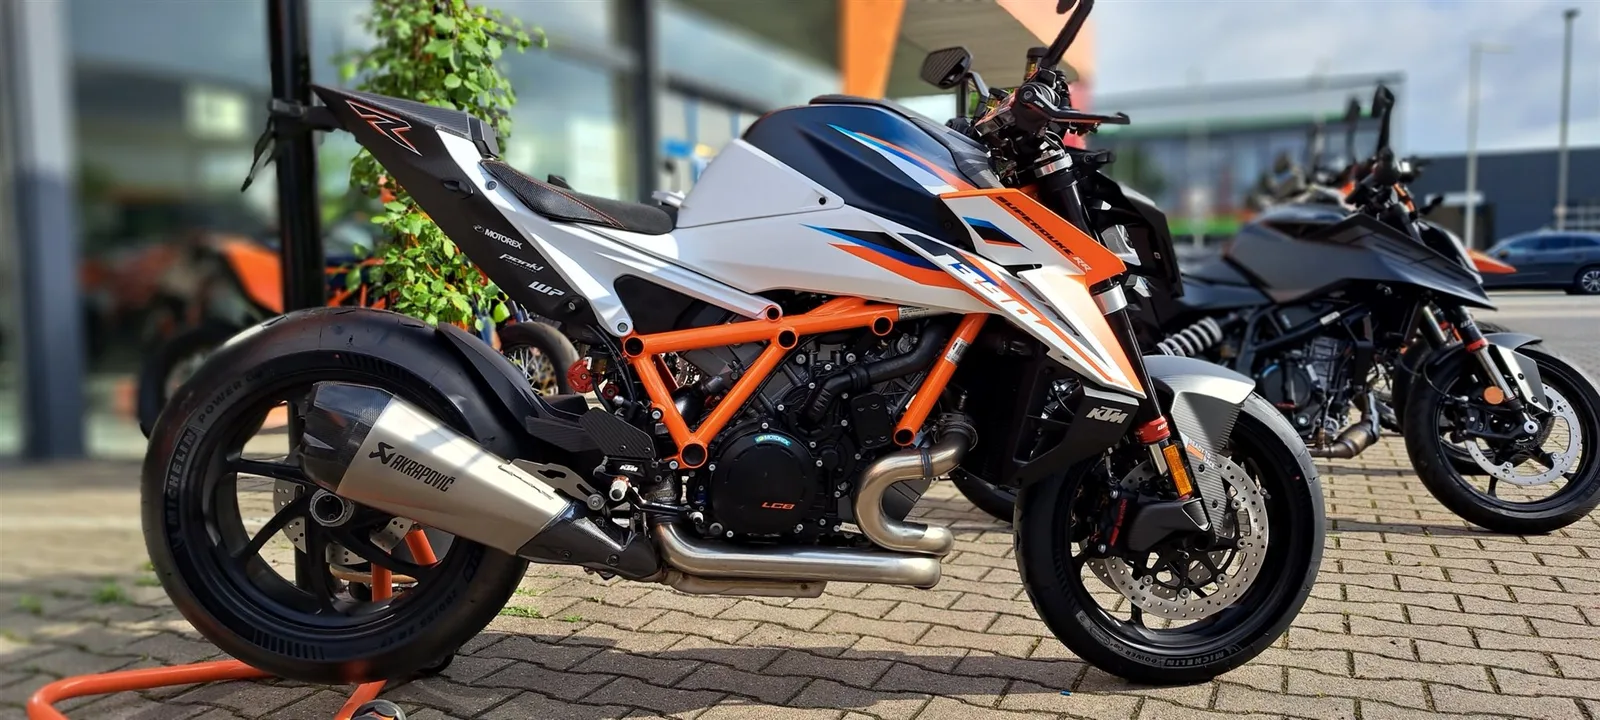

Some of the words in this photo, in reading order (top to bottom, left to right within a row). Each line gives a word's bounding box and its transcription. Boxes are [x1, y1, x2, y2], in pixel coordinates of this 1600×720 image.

[485, 228, 522, 249] MOTOREX
[1073, 256, 1092, 271] RR
[528, 281, 565, 296] WP
[1086, 406, 1128, 424] KTM
[620, 464, 638, 472] KTM
[167, 427, 198, 526] MICHELIN
[1125, 650, 1158, 664] POWER
[1166, 652, 1225, 666] MICHELIN
